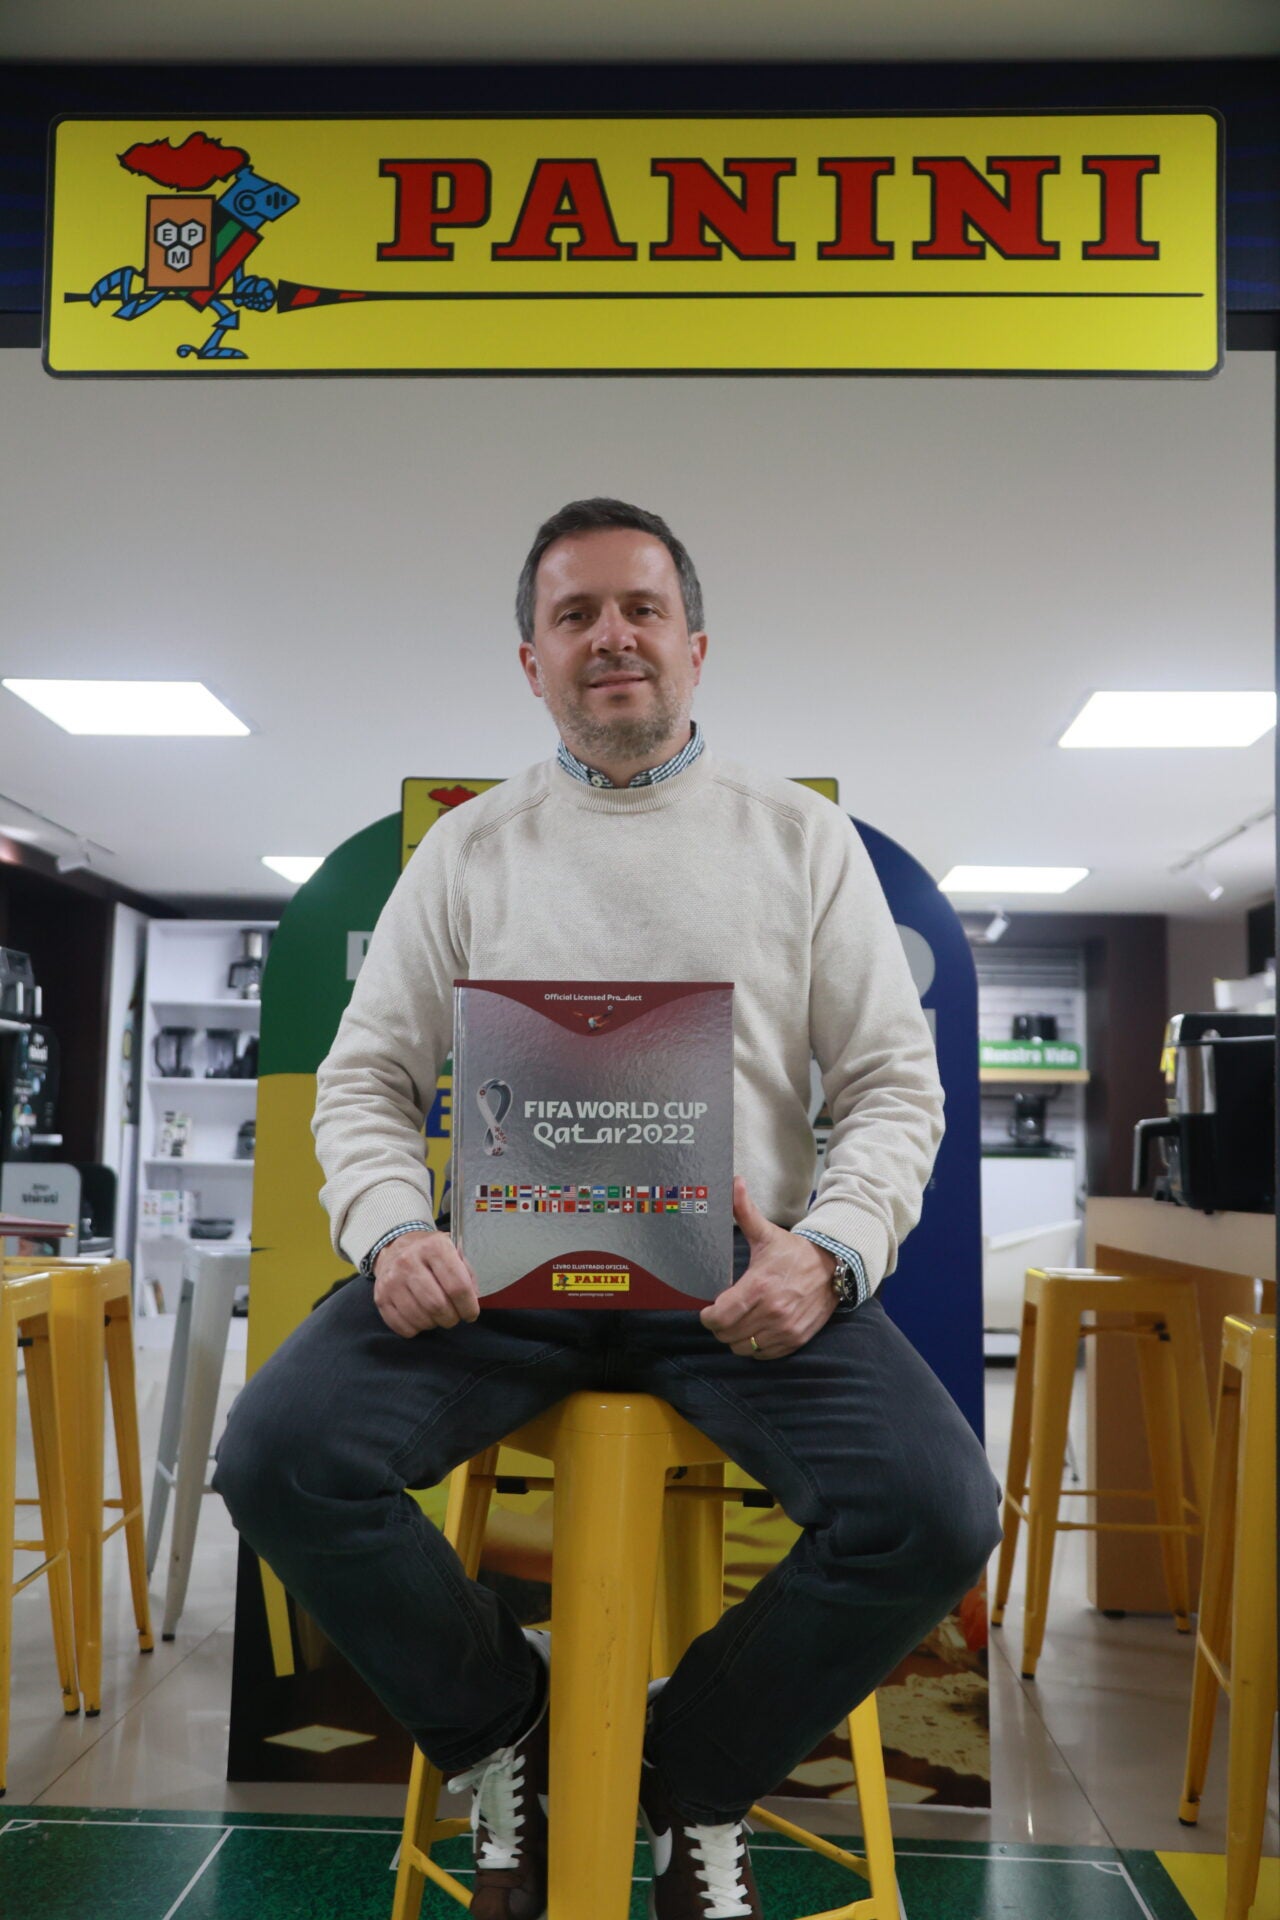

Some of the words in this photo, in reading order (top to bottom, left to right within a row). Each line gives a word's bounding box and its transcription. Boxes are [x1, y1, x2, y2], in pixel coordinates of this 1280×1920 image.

[377, 155, 1160, 262] PANINI
[162, 228, 173, 241] E
[188, 228, 198, 241] P
[172, 251, 186, 264] M
[544, 993, 572, 1001] Official
[573, 993, 606, 1001] Licensed
[524, 1100, 573, 1119] FIFA
[576, 1101, 659, 1120] WORLD
[663, 1101, 708, 1120] CUP
[574, 1275, 626, 1284] PANINI
